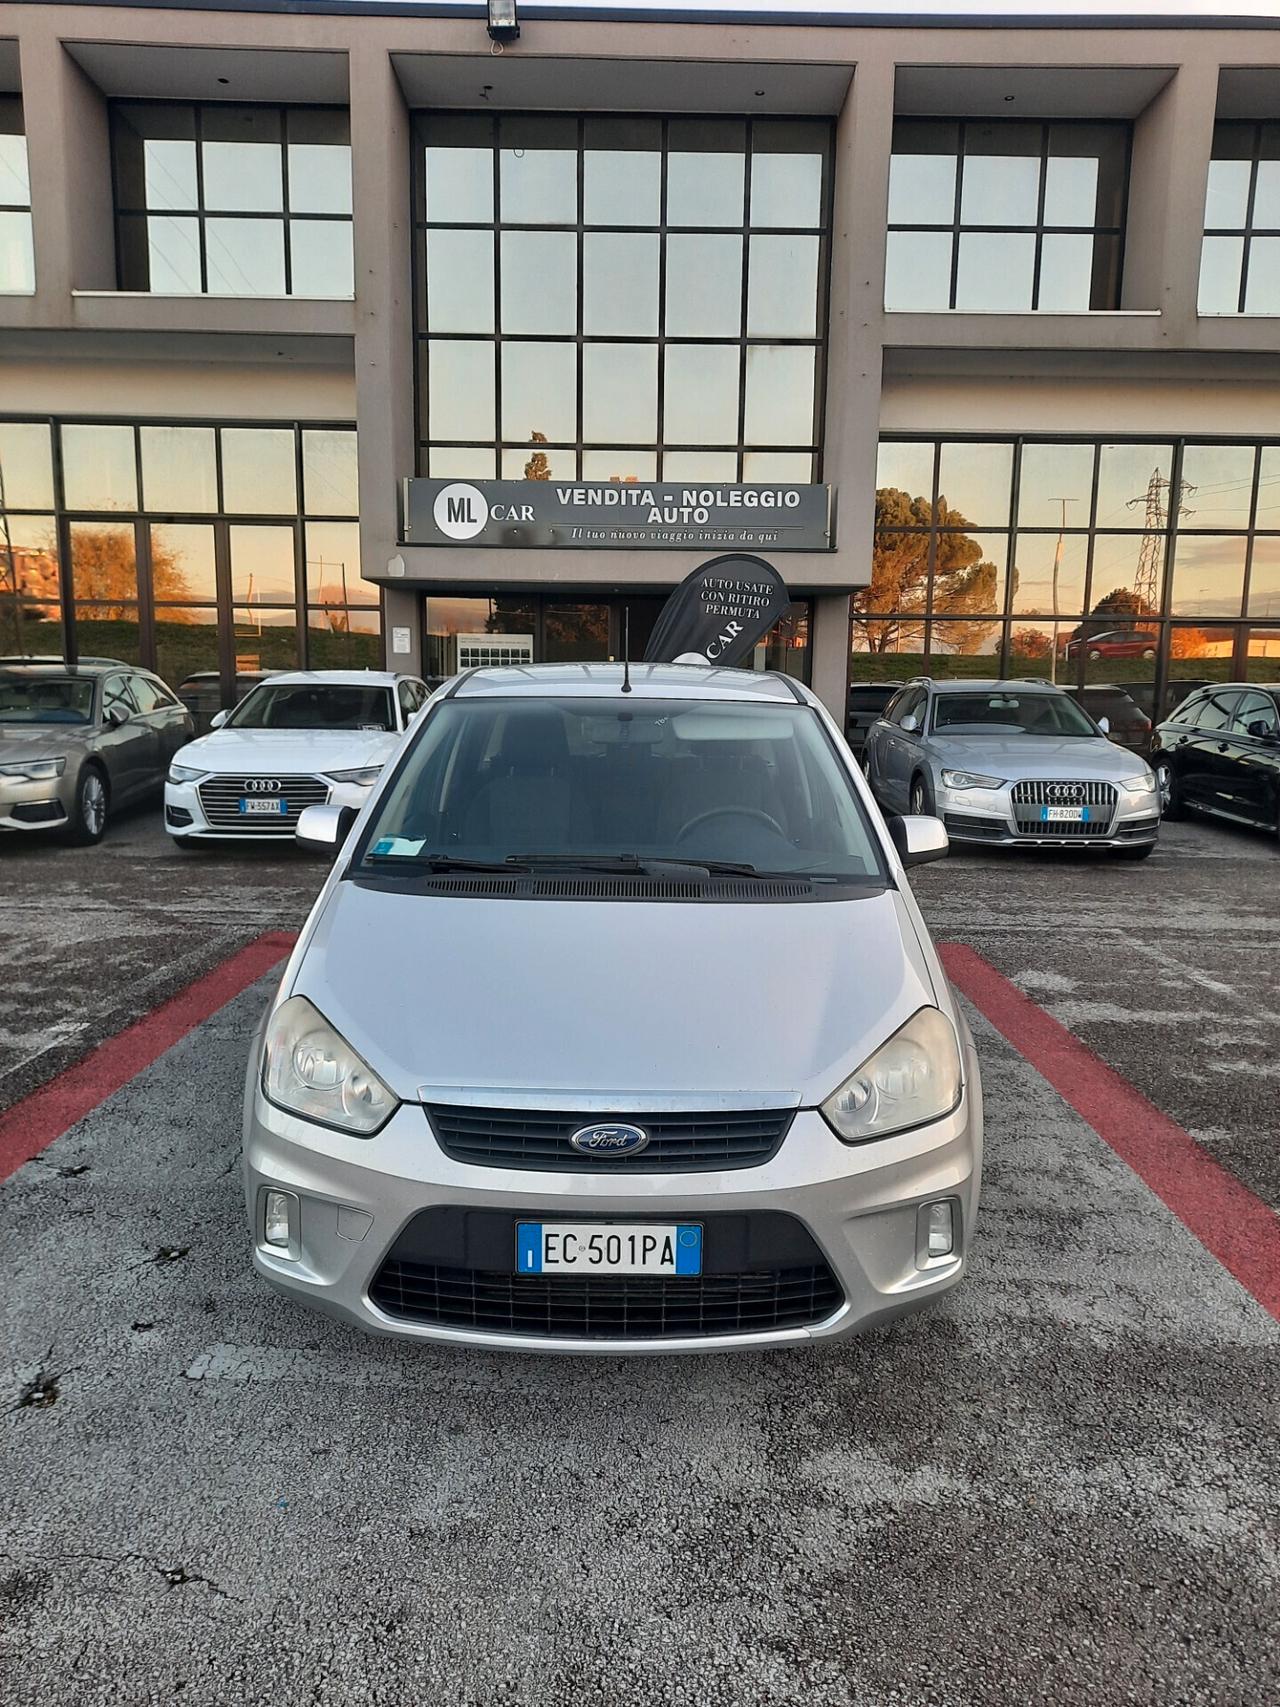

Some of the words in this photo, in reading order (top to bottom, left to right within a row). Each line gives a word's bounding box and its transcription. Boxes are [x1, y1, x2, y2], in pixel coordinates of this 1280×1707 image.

[556, 488, 656, 506] VENDITA
[682, 490, 800, 508] NOLEGGIO
[447, 497, 477, 523] ML
[490, 504, 535, 521] CAR
[647, 507, 710, 524] AUTO
[572, 528, 583, 539] Il
[586, 530, 606, 539] tuo
[610, 531, 646, 540] nuovo
[650, 529, 694, 543] viaggio
[699, 529, 735, 540] inizia
[739, 530, 754, 541] da
[758, 530, 778, 544] qui
[701, 578, 733, 590] AUTO
[736, 581, 774, 595] USATE
[701, 590, 725, 602] CON
[728, 593, 770, 607] RITIRO
[705, 604, 760, 619] PERMUTA
[706, 620, 744, 659] CAR
[588, 1130, 628, 1148] Ford
